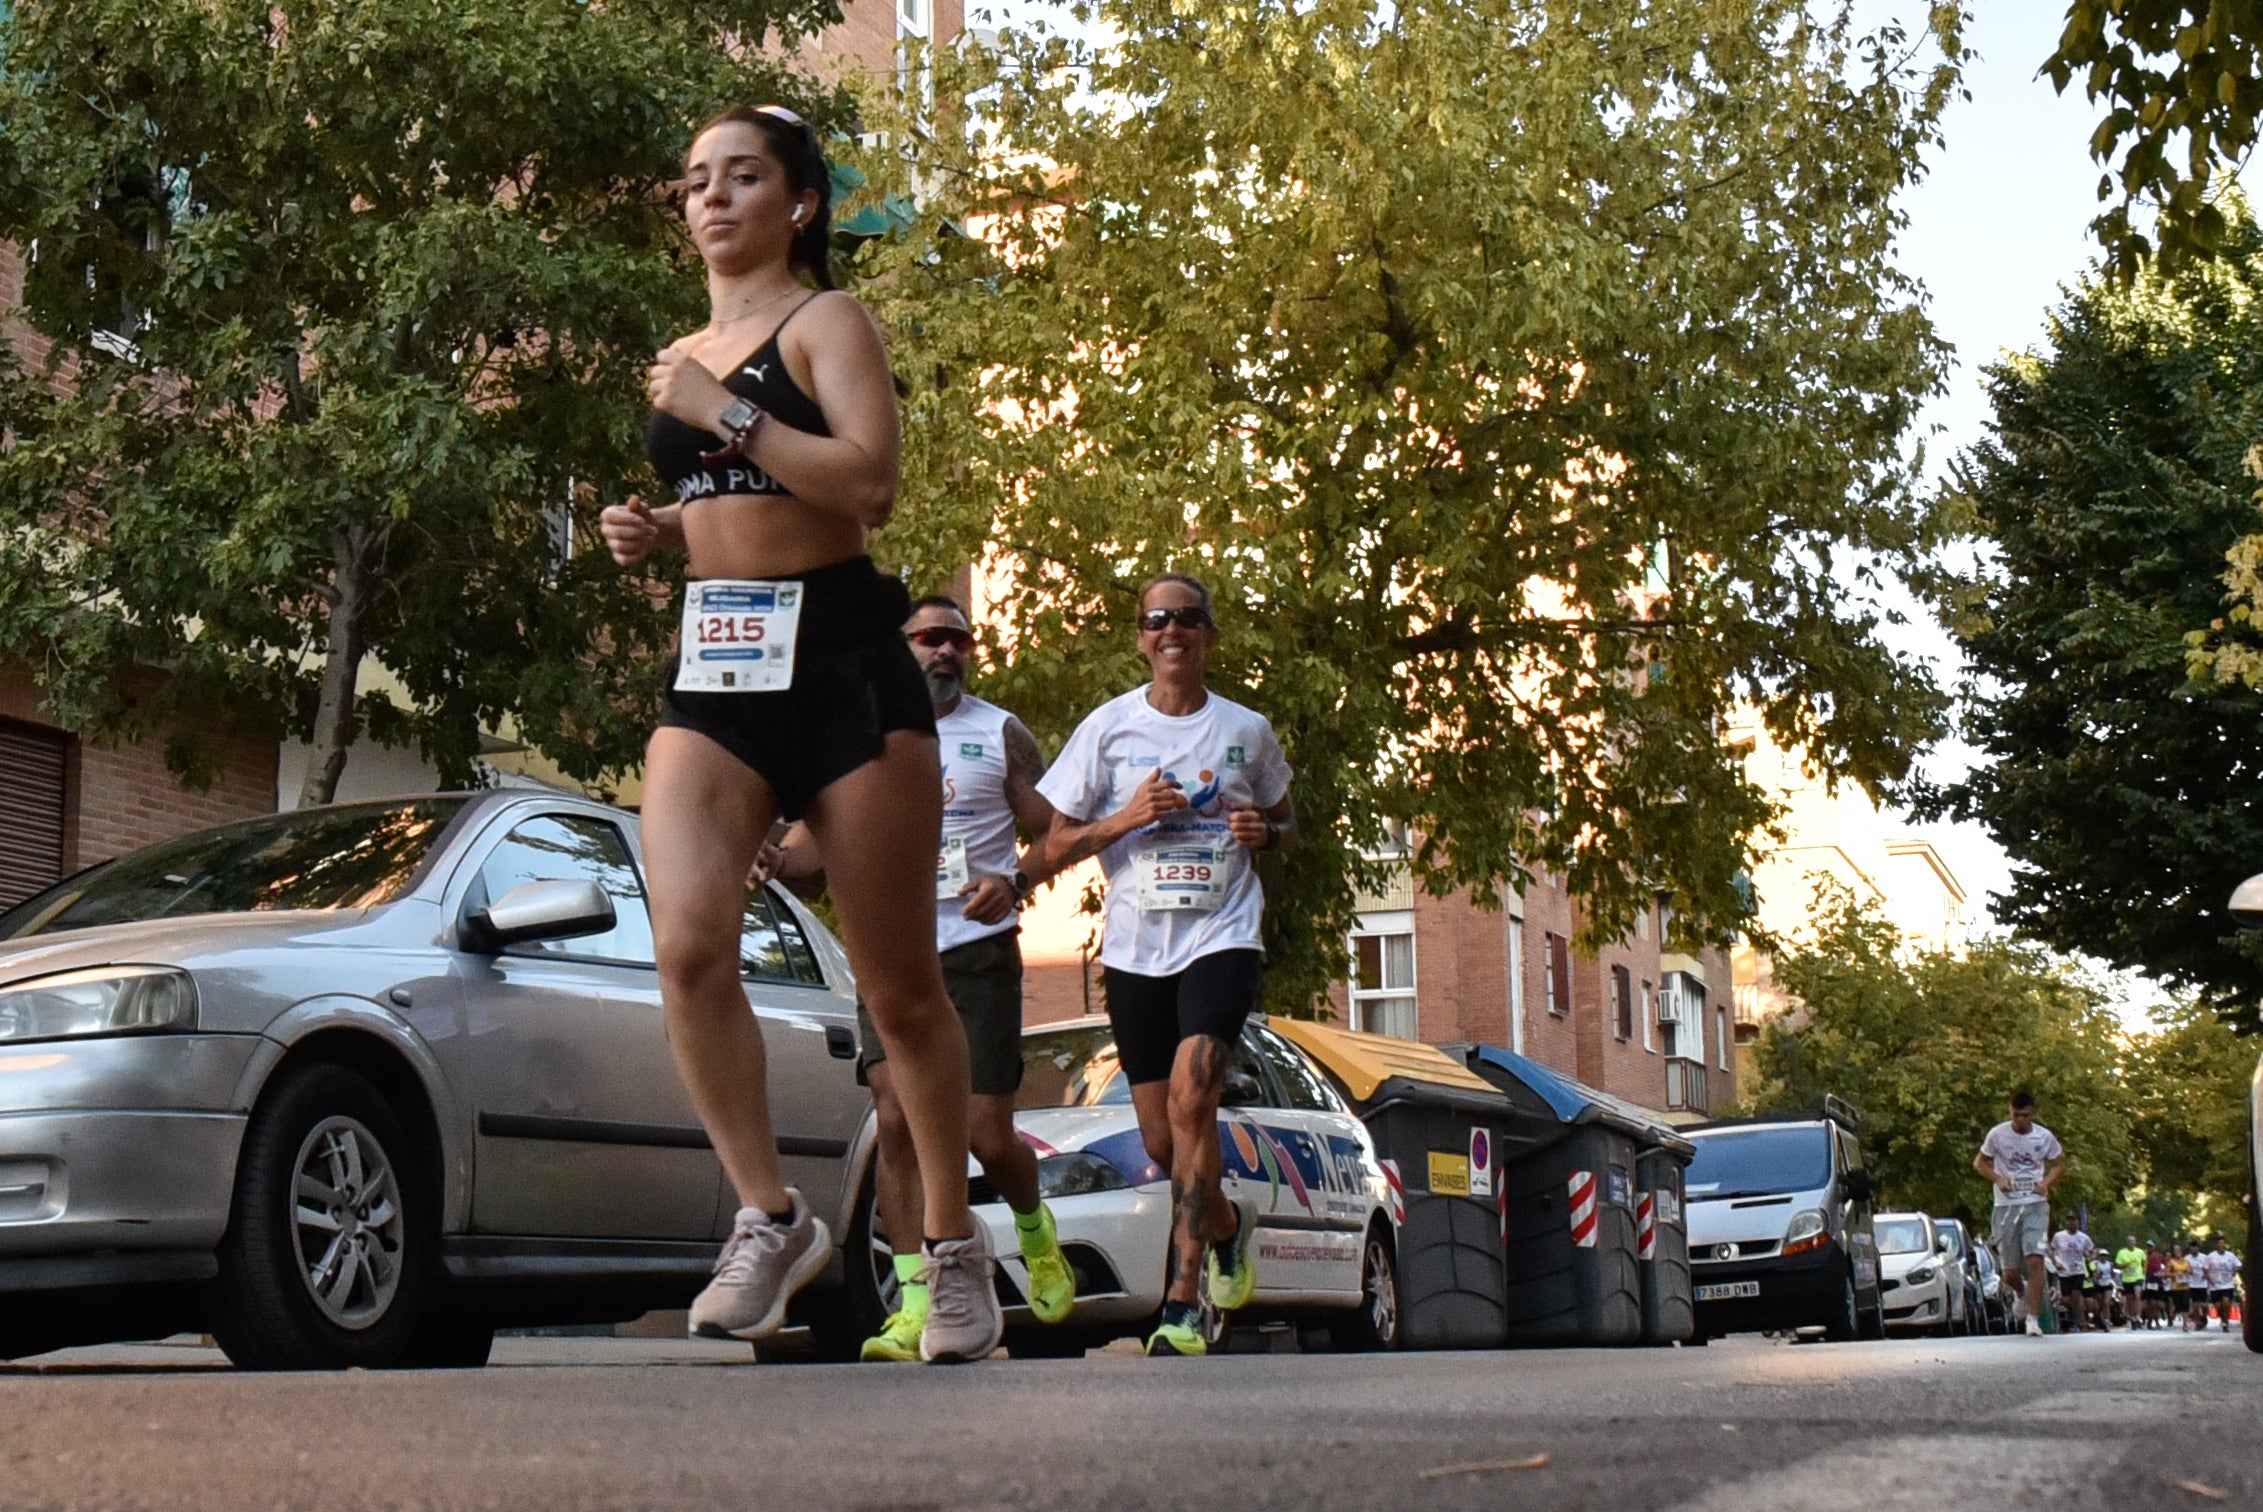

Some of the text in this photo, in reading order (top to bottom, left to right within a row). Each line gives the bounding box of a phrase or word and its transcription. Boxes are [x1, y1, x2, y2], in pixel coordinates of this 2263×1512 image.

[674, 470, 716, 502] UMA
[698, 617, 766, 643] 1215
[1153, 865, 1212, 881] 1239
